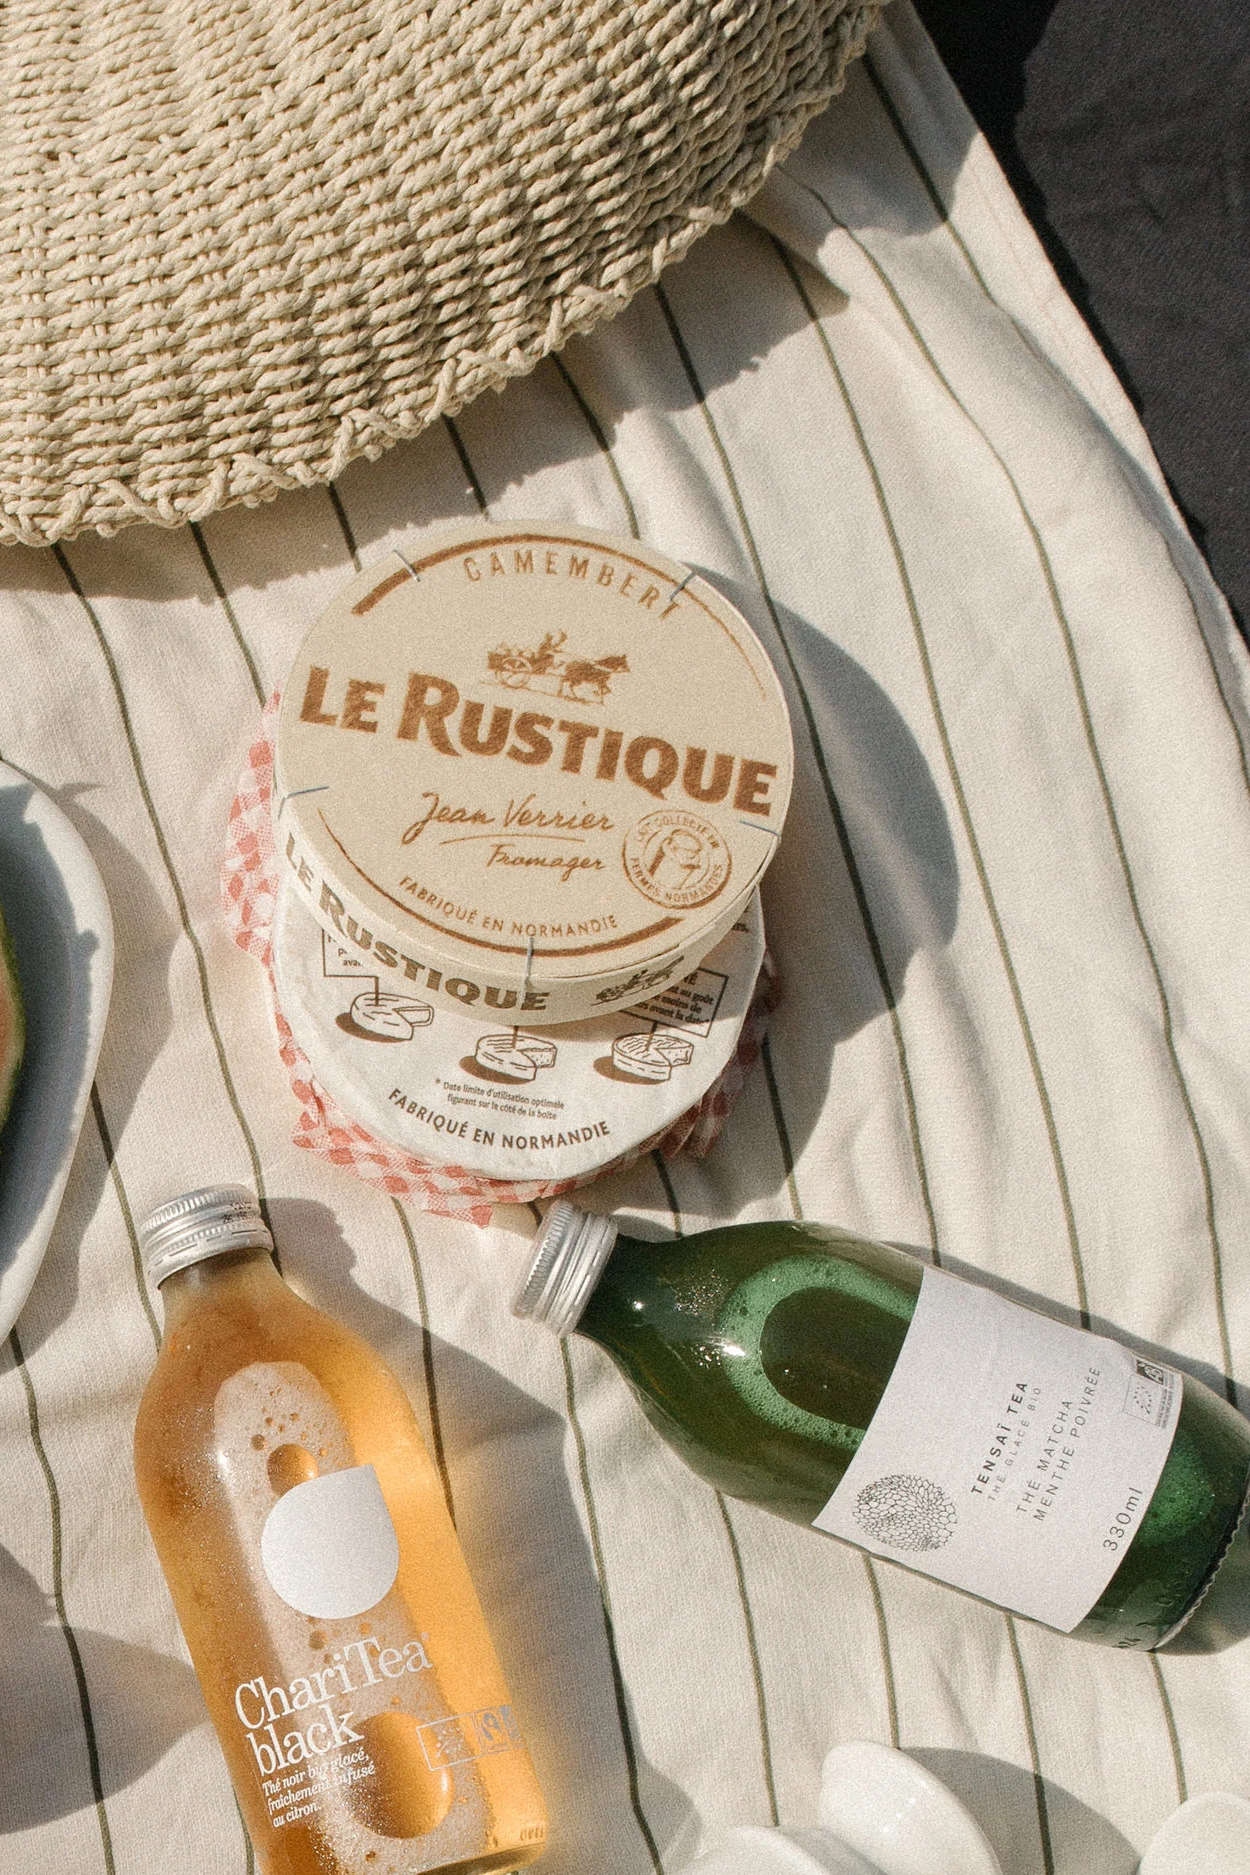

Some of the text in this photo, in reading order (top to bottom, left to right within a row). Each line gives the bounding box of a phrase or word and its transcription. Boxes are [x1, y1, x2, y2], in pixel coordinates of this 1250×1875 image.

[462, 549, 682, 621] CAMEMBERT
[299, 664, 779, 817] LE RUSTIQUE
[401, 792, 615, 845] Jean Verrier
[485, 843, 606, 882] Fromager
[285, 831, 551, 1012] LE RUSTIQUE
[399, 876, 619, 938] FABRIQUÉ EN NORMANDIE
[388, 1087, 612, 1151] FABRIQUÉ EN NORMANDIE
[443, 1081, 462, 1092] Date
[462, 1084, 485, 1097] limite
[478, 1099, 490, 1109] sur
[1027, 1386, 1042, 1412] BIO
[970, 1381, 1028, 1495] TENSAÏ TEA
[1033, 1366, 1101, 1521] MENTHE POIVRÉE
[1036, 1400, 1073, 1473] MATCHA
[1102, 1485, 1144, 1552] 330ml
[234, 1636, 434, 1730] ChariTea
[246, 1701, 366, 1777] black
[261, 1777, 283, 1798] Thé
[282, 1769, 308, 1787] noir
[272, 1815, 287, 1829] au
